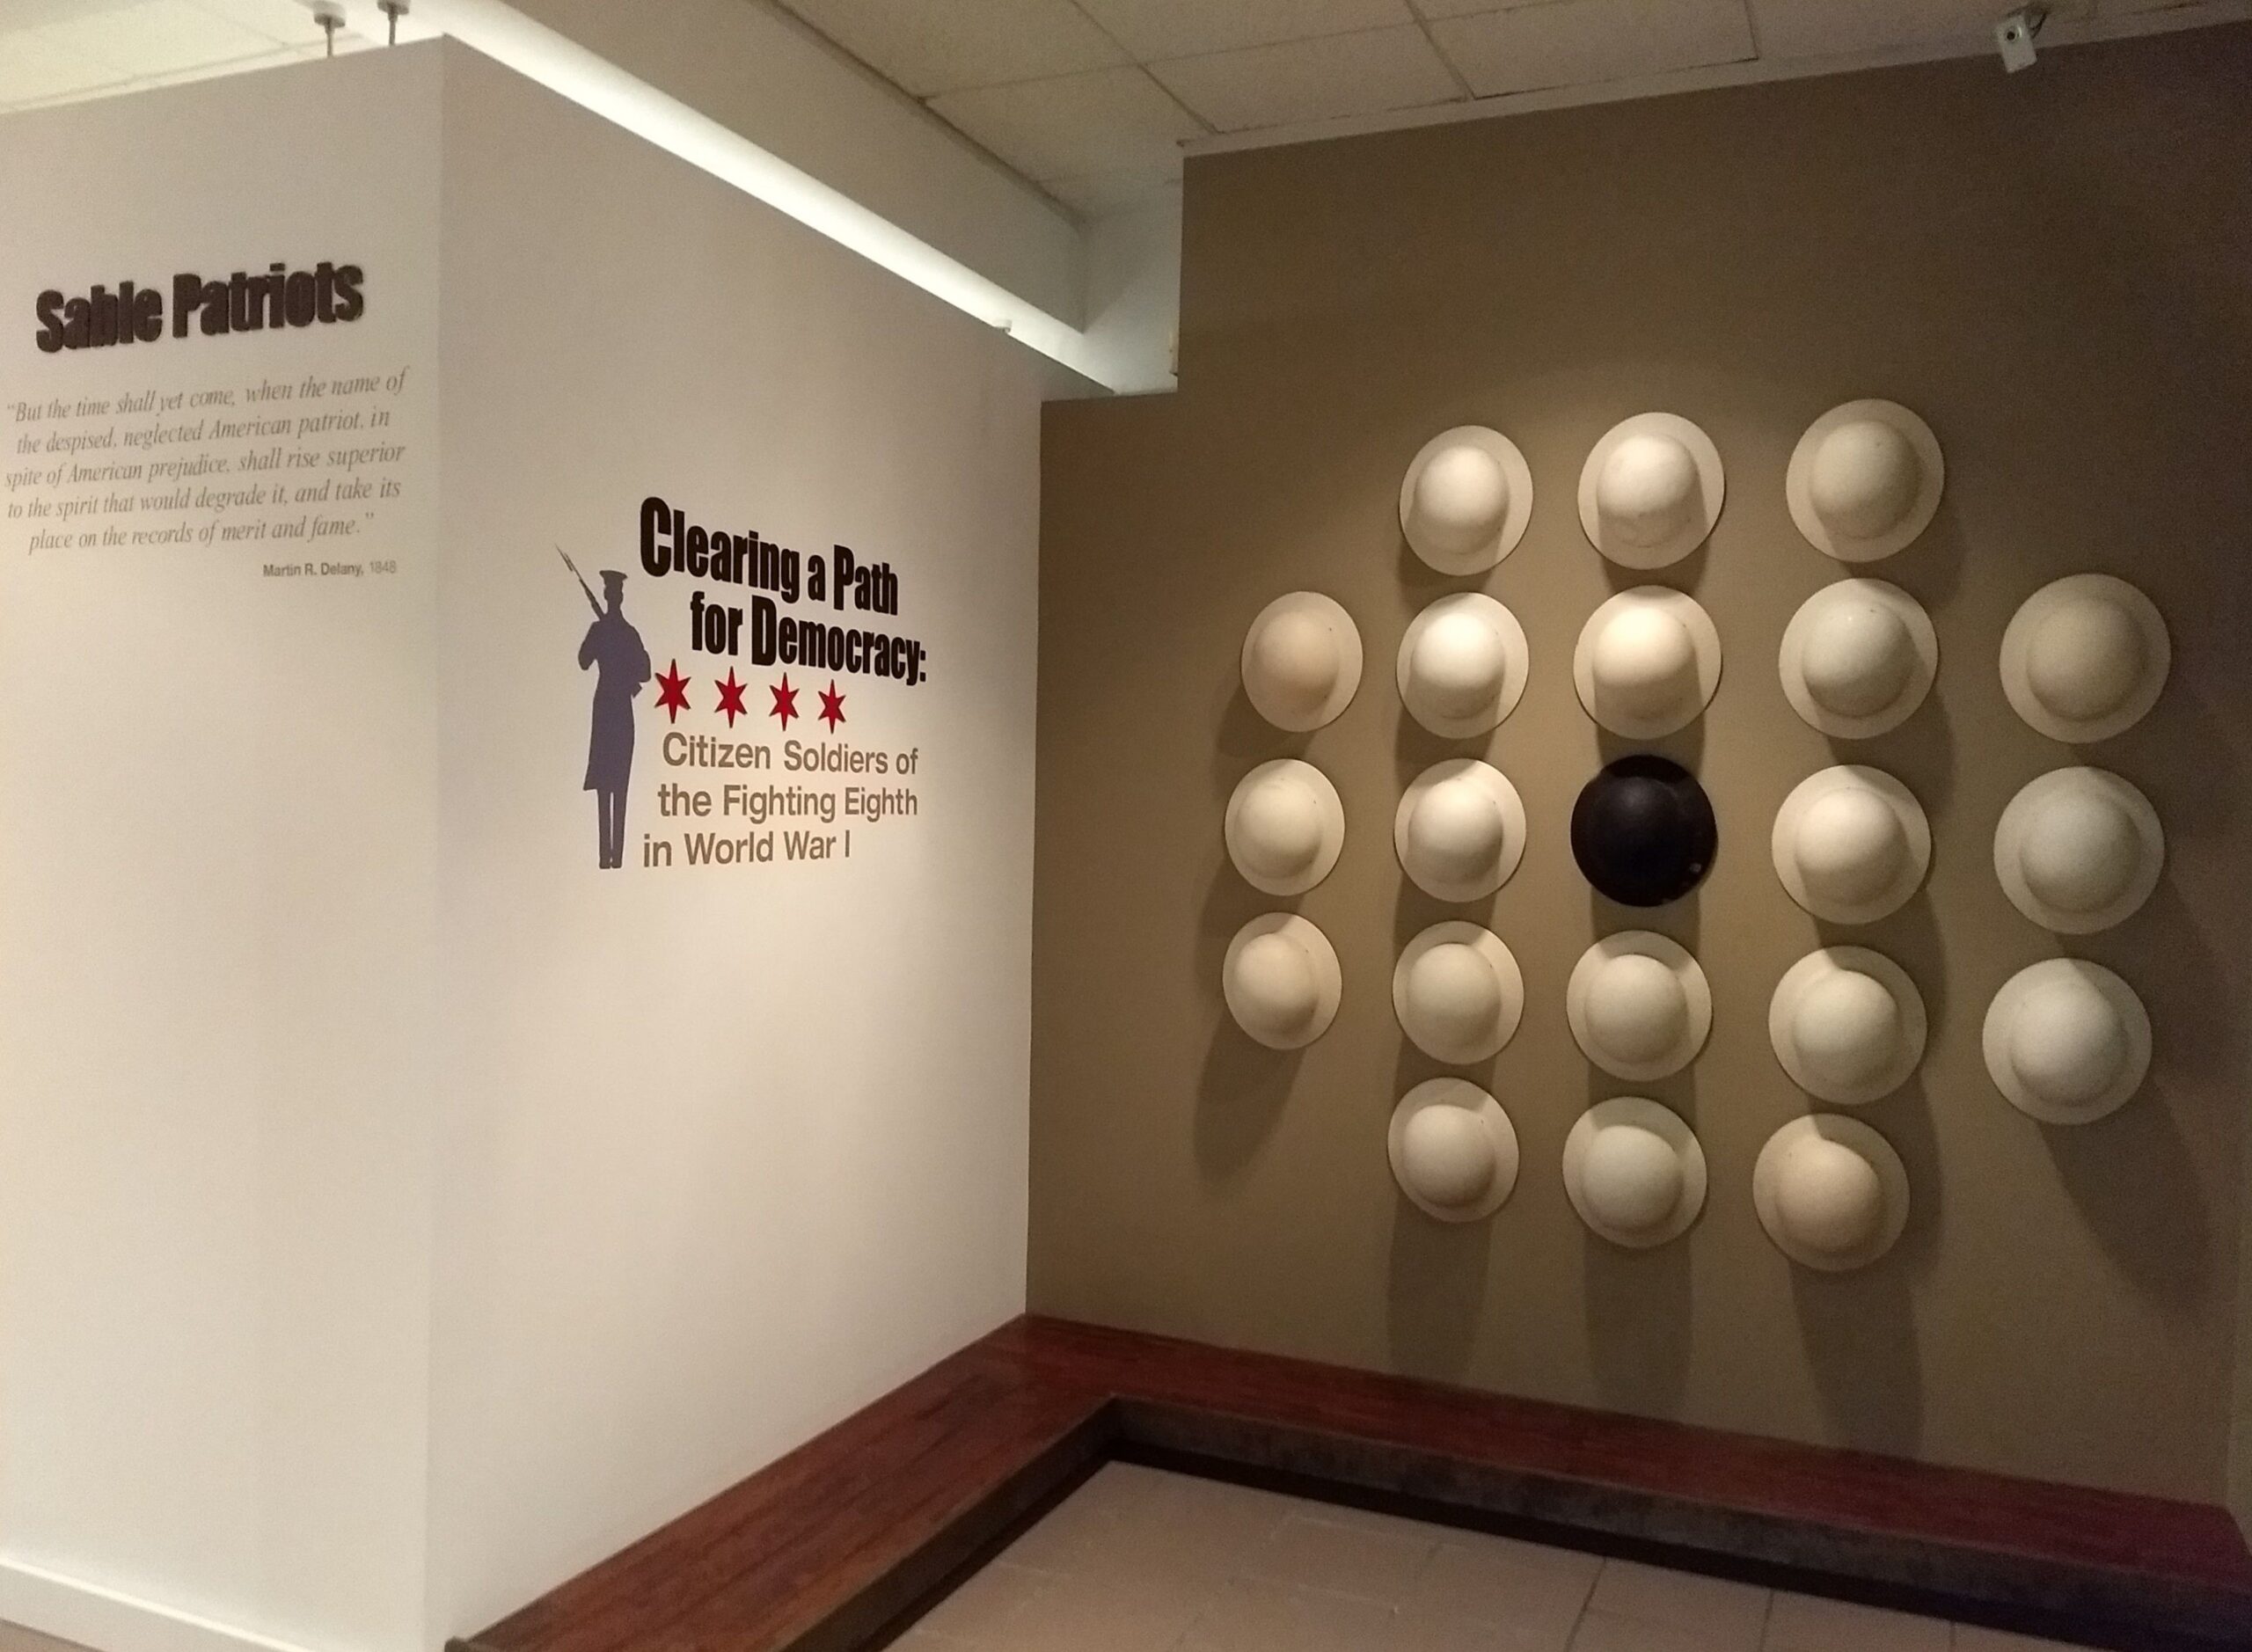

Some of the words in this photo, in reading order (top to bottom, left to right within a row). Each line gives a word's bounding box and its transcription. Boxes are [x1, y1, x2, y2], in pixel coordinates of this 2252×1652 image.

[36, 280, 163, 352] Sable
[172, 261, 363, 338] Patriots
[48, 397, 70, 420] the
[76, 397, 110, 417] time
[116, 390, 156, 414] shall
[157, 393, 183, 417] yet
[245, 380, 292, 402] when
[300, 376, 325, 398] the
[331, 376, 380, 396] name
[385, 366, 411, 396] of
[17, 434, 40, 454] the
[123, 417, 202, 450] neglected
[208, 418, 292, 440] American
[370, 407, 390, 428] in
[4, 467, 40, 492] spite
[46, 461, 66, 486] of
[67, 461, 143, 484] American
[239, 447, 282, 471] shall
[286, 445, 320, 468] rise
[326, 441, 406, 471] superior
[8, 501, 22, 519] to
[28, 498, 51, 517] the
[55, 493, 99, 519] spirit
[104, 492, 134, 513] that
[140, 487, 190, 511] would
[195, 480, 267, 512] degrade
[295, 479, 329, 503] and
[335, 476, 372, 500] take
[378, 476, 401, 498] its
[27, 529, 72, 556] place
[78, 533, 97, 548] on
[102, 523, 127, 546] the
[132, 520, 193, 545] records
[198, 515, 218, 545] of
[221, 518, 267, 541] merit
[272, 515, 304, 538] and
[640, 496, 800, 603] Clearing
[808, 555, 825, 601] a
[834, 544, 898, 615] Path
[263, 562, 301, 577] Martin
[305, 562, 317, 575] R.
[320, 561, 364, 578] Delany,
[691, 591, 742, 655] for
[751, 595, 926, 686] Democracy:
[662, 732, 771, 770] Citizen
[784, 740, 888, 773] Soldiers
[896, 748, 918, 774] of
[658, 784, 712, 816] the
[723, 785, 837, 824] Fighting
[844, 786, 918, 822] Eighth
[644, 834, 671, 867] in
[684, 831, 773, 865] World
[784, 831, 837, 860] War
[844, 830, 851, 858] I
